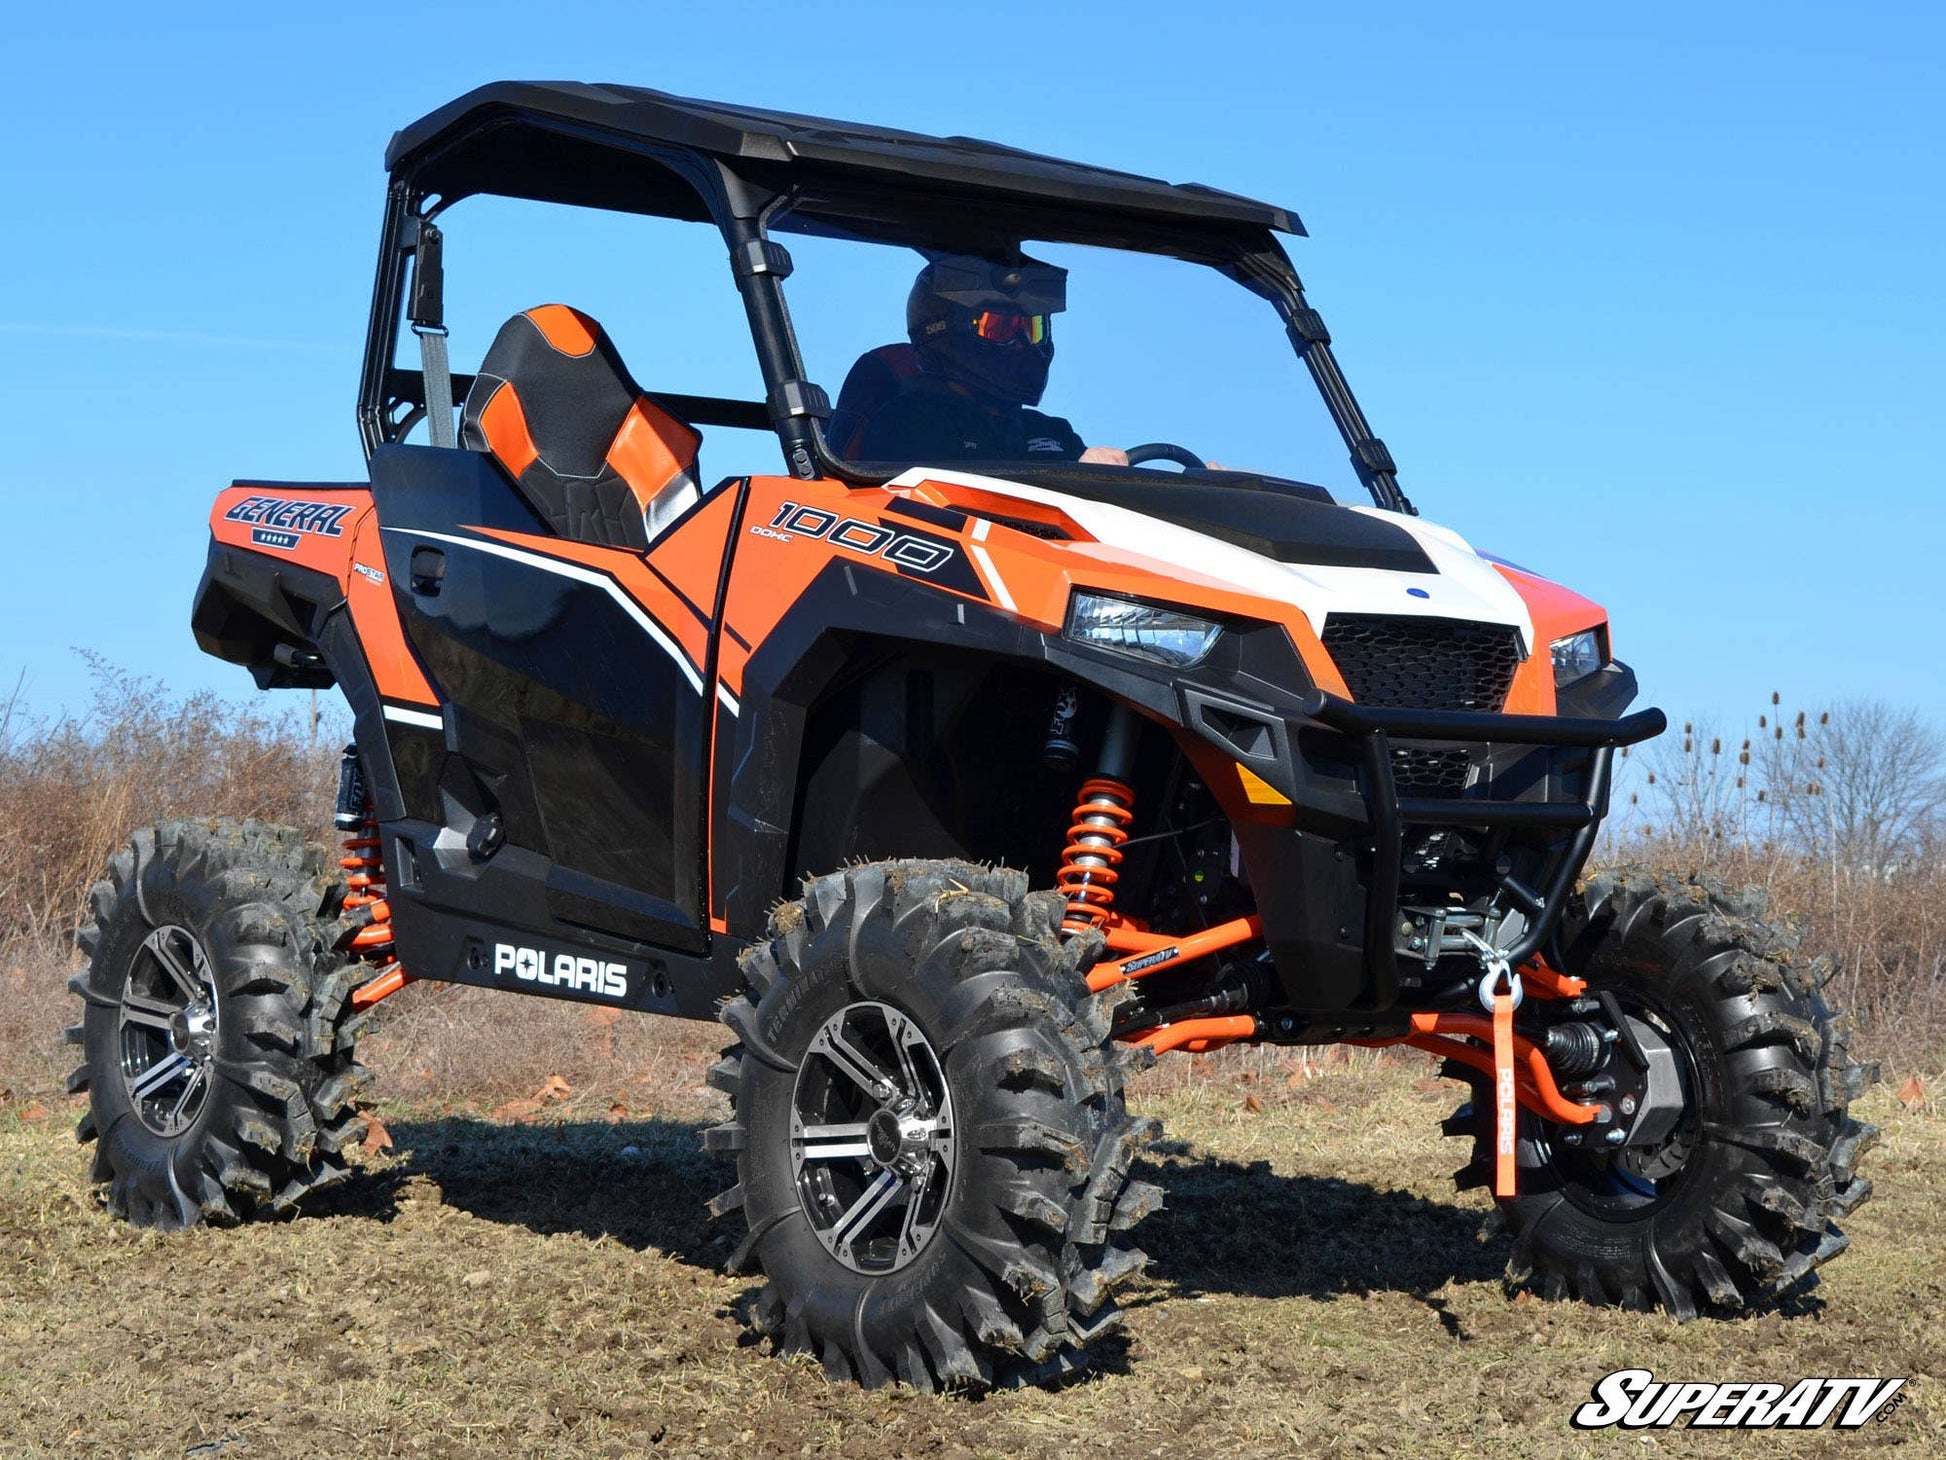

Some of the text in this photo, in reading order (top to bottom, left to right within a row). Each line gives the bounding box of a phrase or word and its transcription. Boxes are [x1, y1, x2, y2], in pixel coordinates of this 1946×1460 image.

[224, 495, 356, 538] GENERAL
[749, 525, 794, 543] DOHC
[769, 501, 954, 572] 1000
[494, 943, 628, 998] POLARIS
[1498, 1068, 1514, 1155] POLARIS
